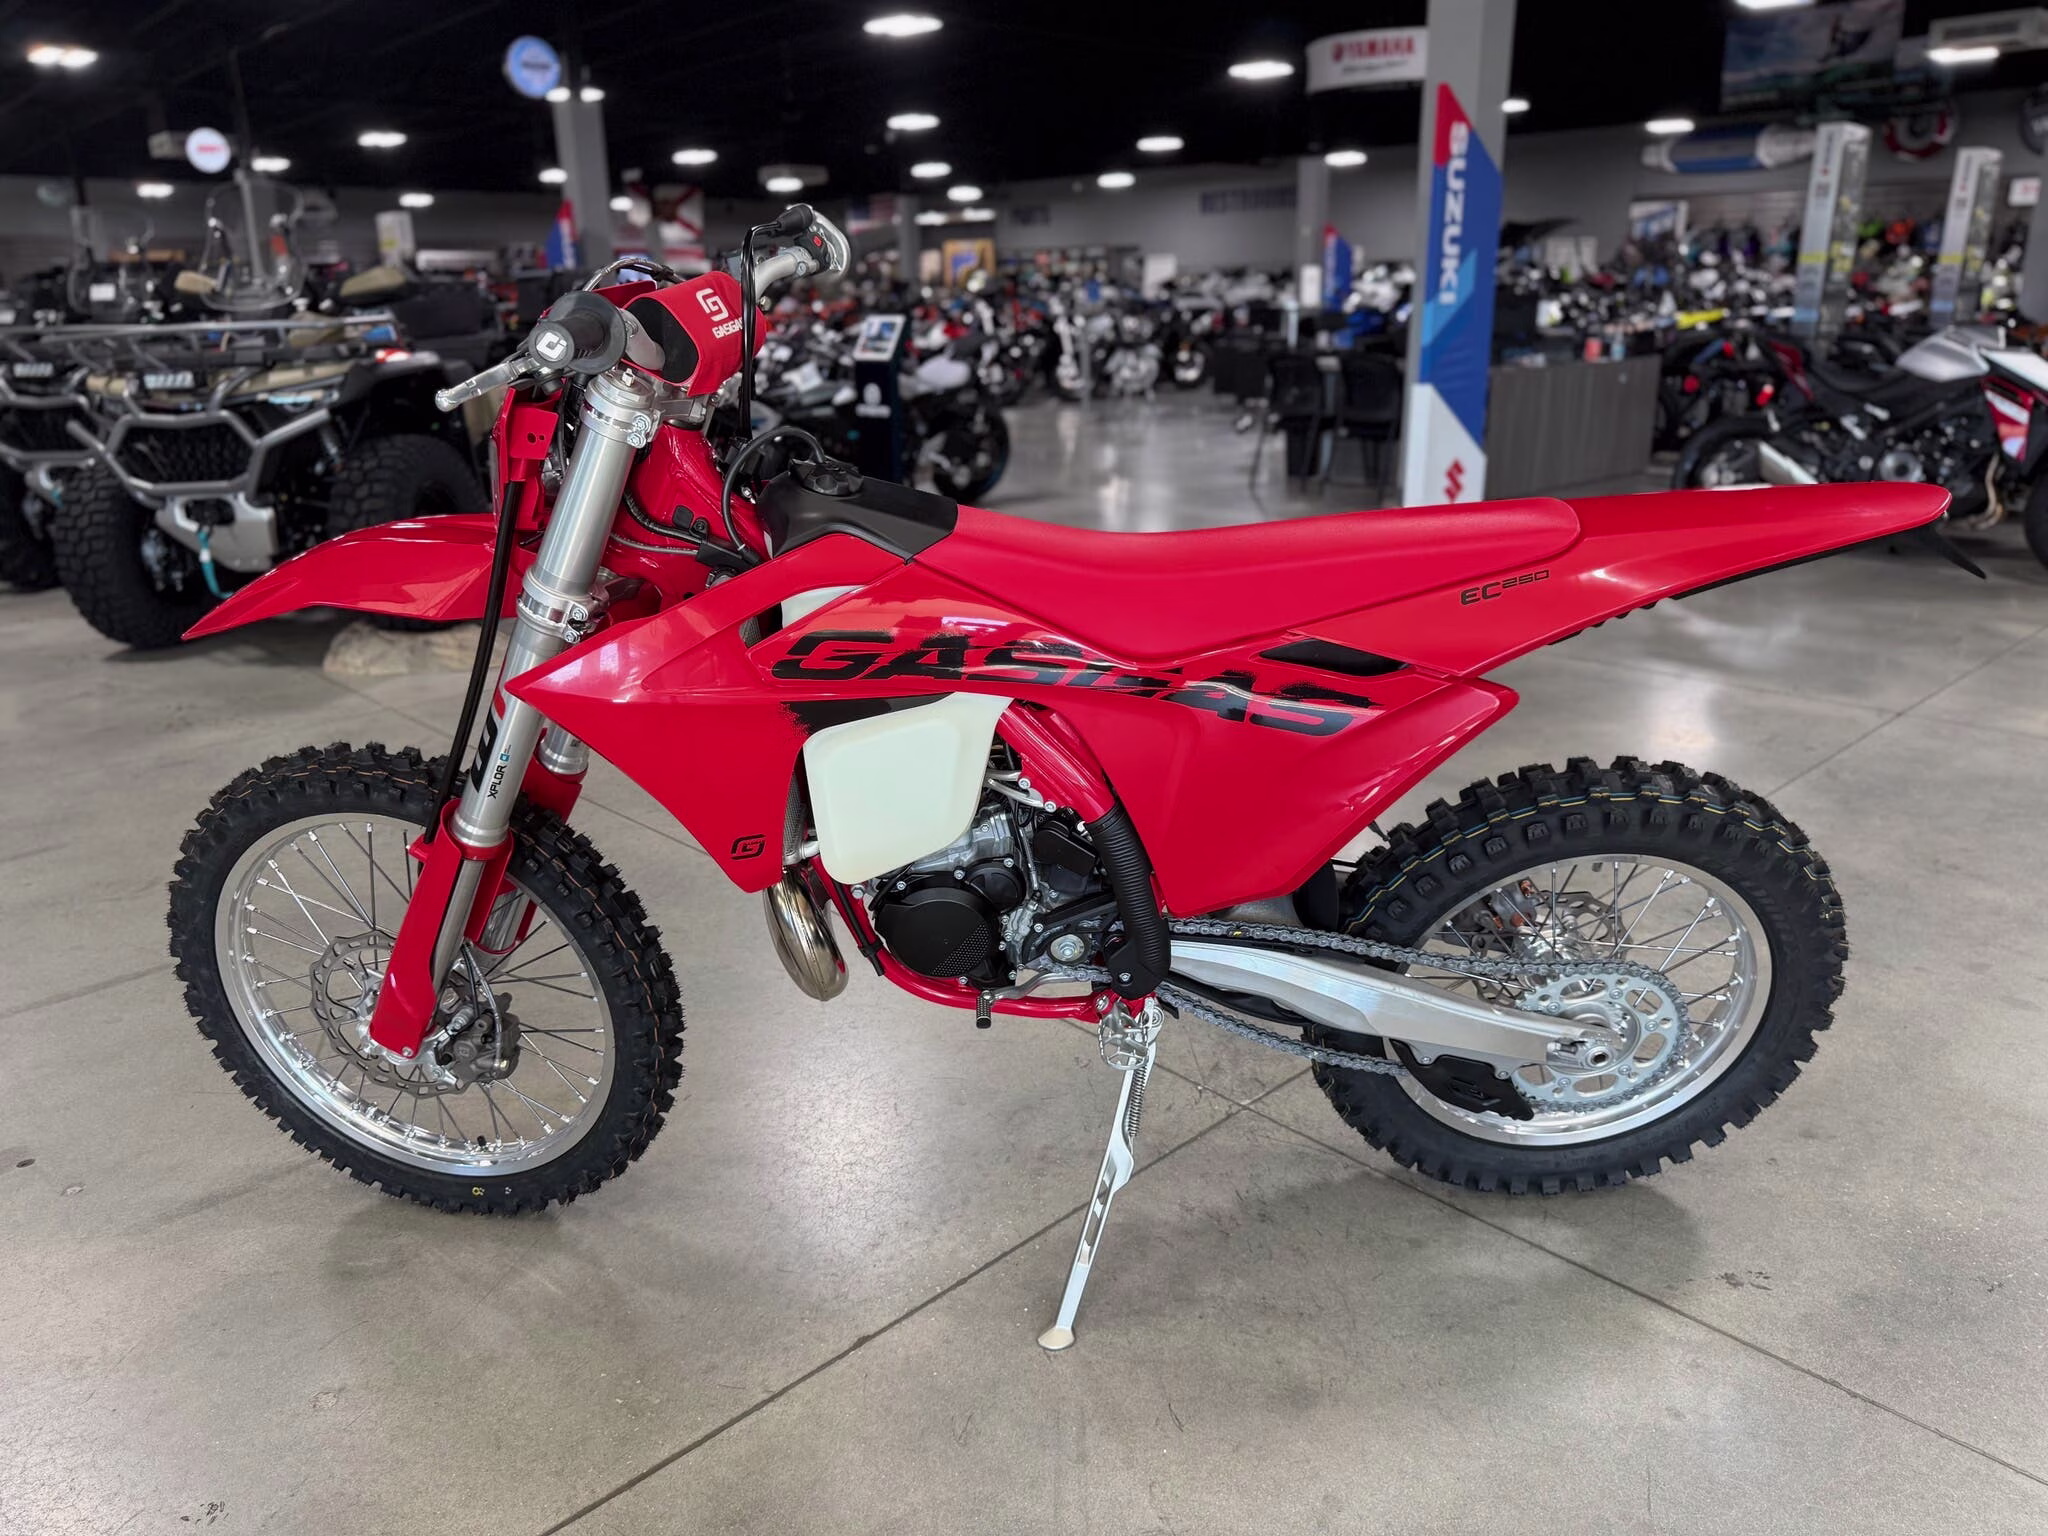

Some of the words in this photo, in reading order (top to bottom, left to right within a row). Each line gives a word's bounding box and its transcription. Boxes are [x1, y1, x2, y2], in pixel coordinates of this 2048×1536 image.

[1438, 119, 1470, 305] SUZUKI
[1460, 569, 1550, 606] EC250
[487, 763, 508, 800] XPLOR
